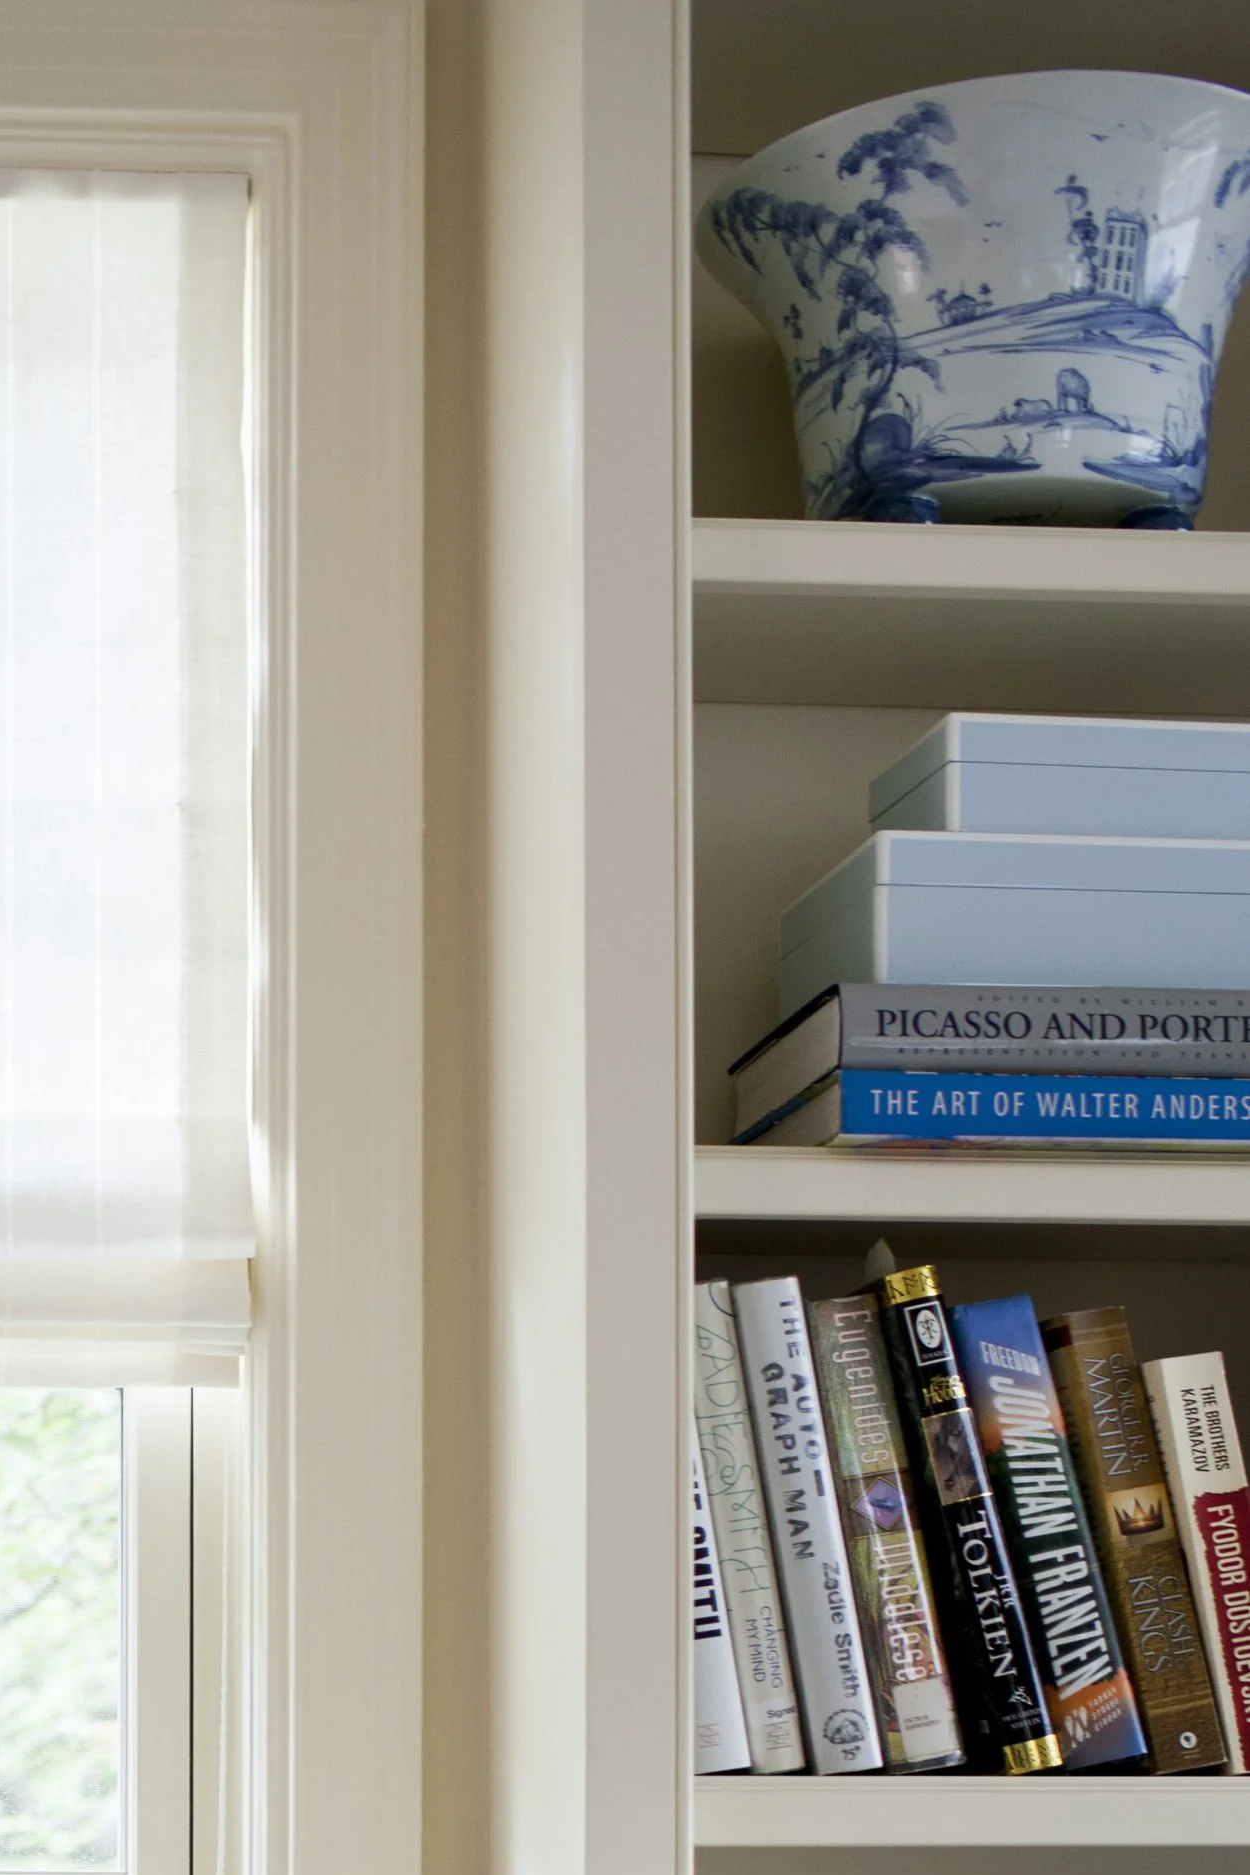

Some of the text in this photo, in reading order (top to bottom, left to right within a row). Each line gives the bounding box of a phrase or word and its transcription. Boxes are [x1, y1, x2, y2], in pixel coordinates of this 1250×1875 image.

[875, 1009, 1032, 1039] PICASSO
[1041, 1012, 1126, 1041] AND
[870, 1089, 1250, 1120] THE ART OF WALTER ANDERS
[779, 1296, 802, 1359] THE
[979, 1341, 1042, 1377] FREEDOM
[832, 1308, 894, 1464] Eugenides
[1083, 1358, 1132, 1476] MARTIN
[1109, 1352, 1141, 1428] GEORGE
[1200, 1384, 1230, 1471] THE BROTHERS
[761, 1361, 814, 1560] GRAPH MAN
[988, 1374, 1078, 1539] JONATHAN
[1180, 1388, 1210, 1472] KARAMAZOV
[1206, 1503, 1248, 1586] FYODOR
[822, 1561, 861, 1698] Zadie Smith
[957, 1508, 1018, 1678] TOLKIEN
[1028, 1544, 1114, 1701] FRANZEN
[1129, 1575, 1171, 1672] KINGS
[1158, 1575, 1195, 1655] CLASH
[746, 1618, 767, 1683] MY MIND
[759, 1605, 784, 1689] CHANGING
